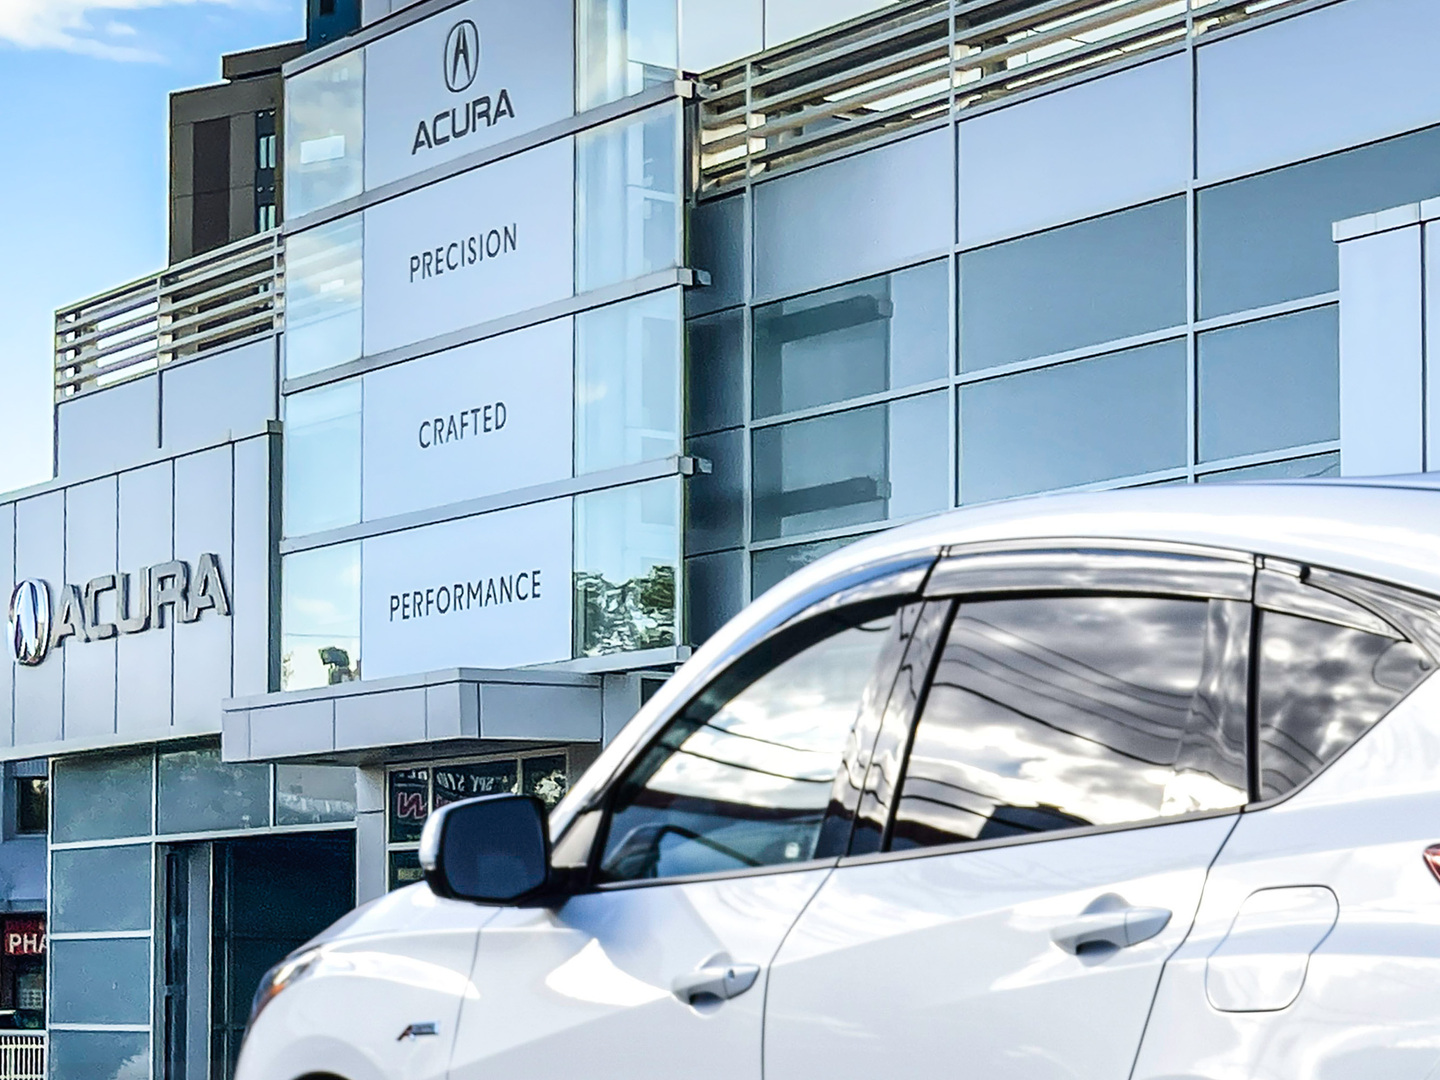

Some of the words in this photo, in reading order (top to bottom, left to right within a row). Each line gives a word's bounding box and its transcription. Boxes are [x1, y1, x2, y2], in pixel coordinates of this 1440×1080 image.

[411, 89, 515, 155] ACURA
[409, 223, 518, 283] PRECISION
[418, 402, 507, 448] CRAFTED
[50, 553, 233, 648] ACURA
[389, 570, 542, 621] PERFORMANCE
